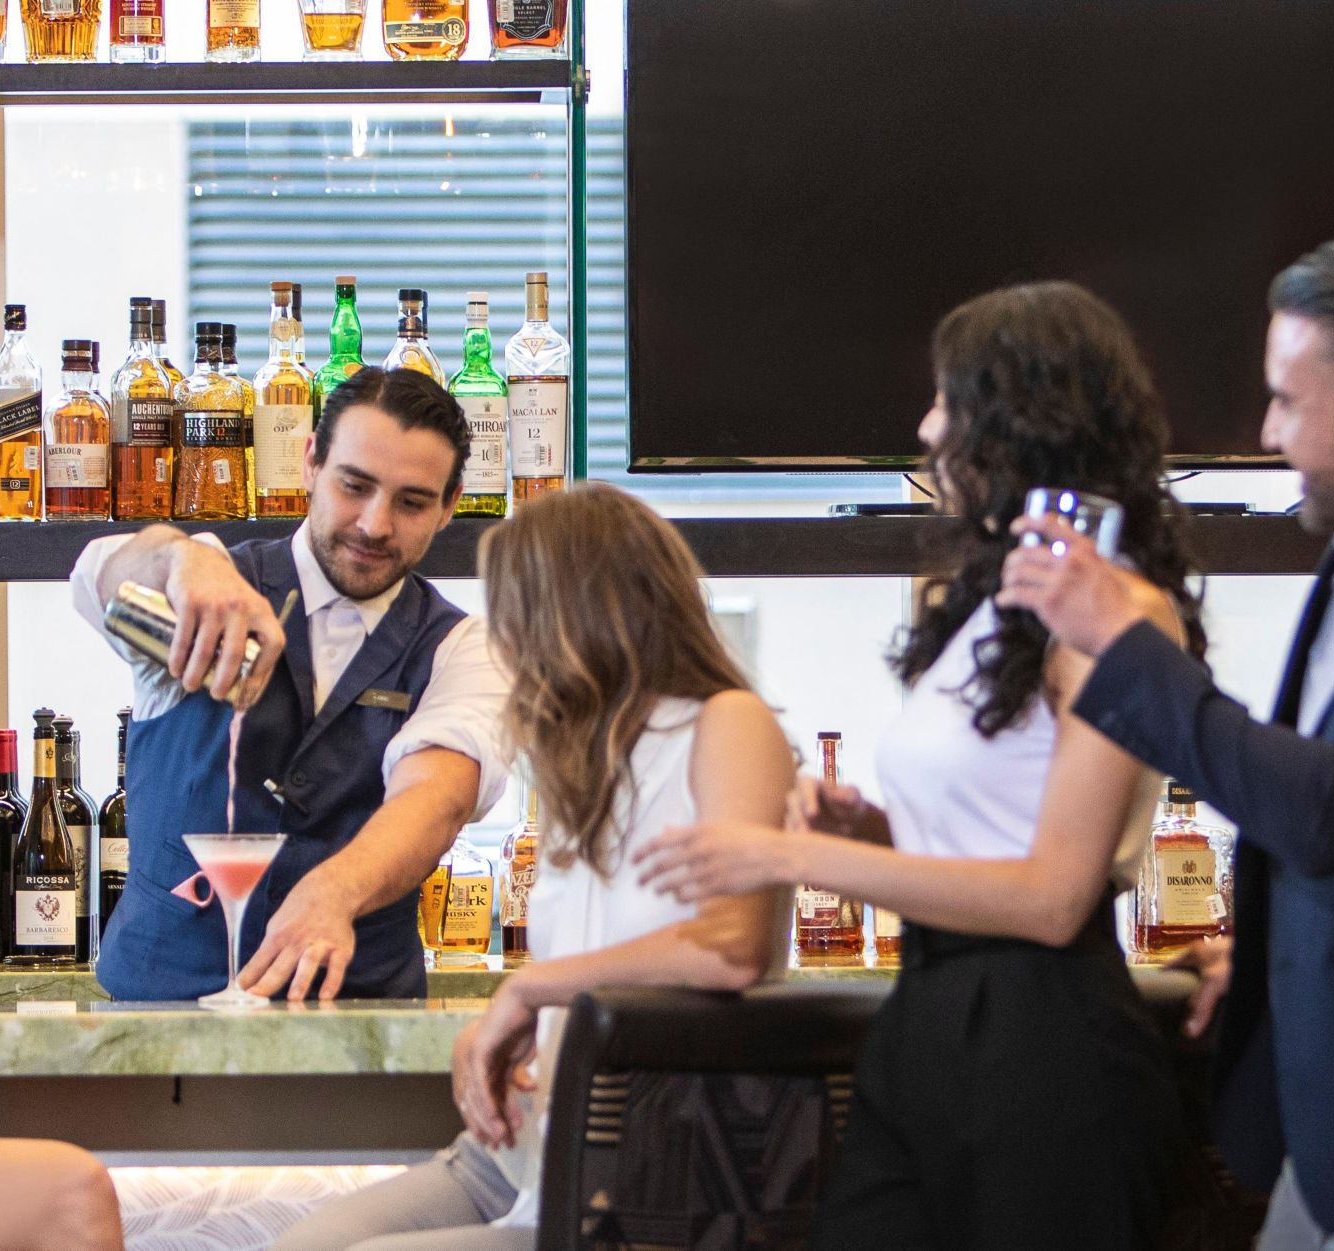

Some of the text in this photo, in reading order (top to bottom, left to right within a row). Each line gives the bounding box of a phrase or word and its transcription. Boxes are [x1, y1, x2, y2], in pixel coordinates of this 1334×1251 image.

[447, 23, 460, 35] 18
[133, 423, 141, 431] 12
[186, 428, 226, 437] PARK 12
[527, 428, 541, 439] 12
[48, 447, 82, 456] ABERLOUR
[26, 876, 70, 884] RICOSSA
[1167, 876, 1213, 887] DISARONNO
